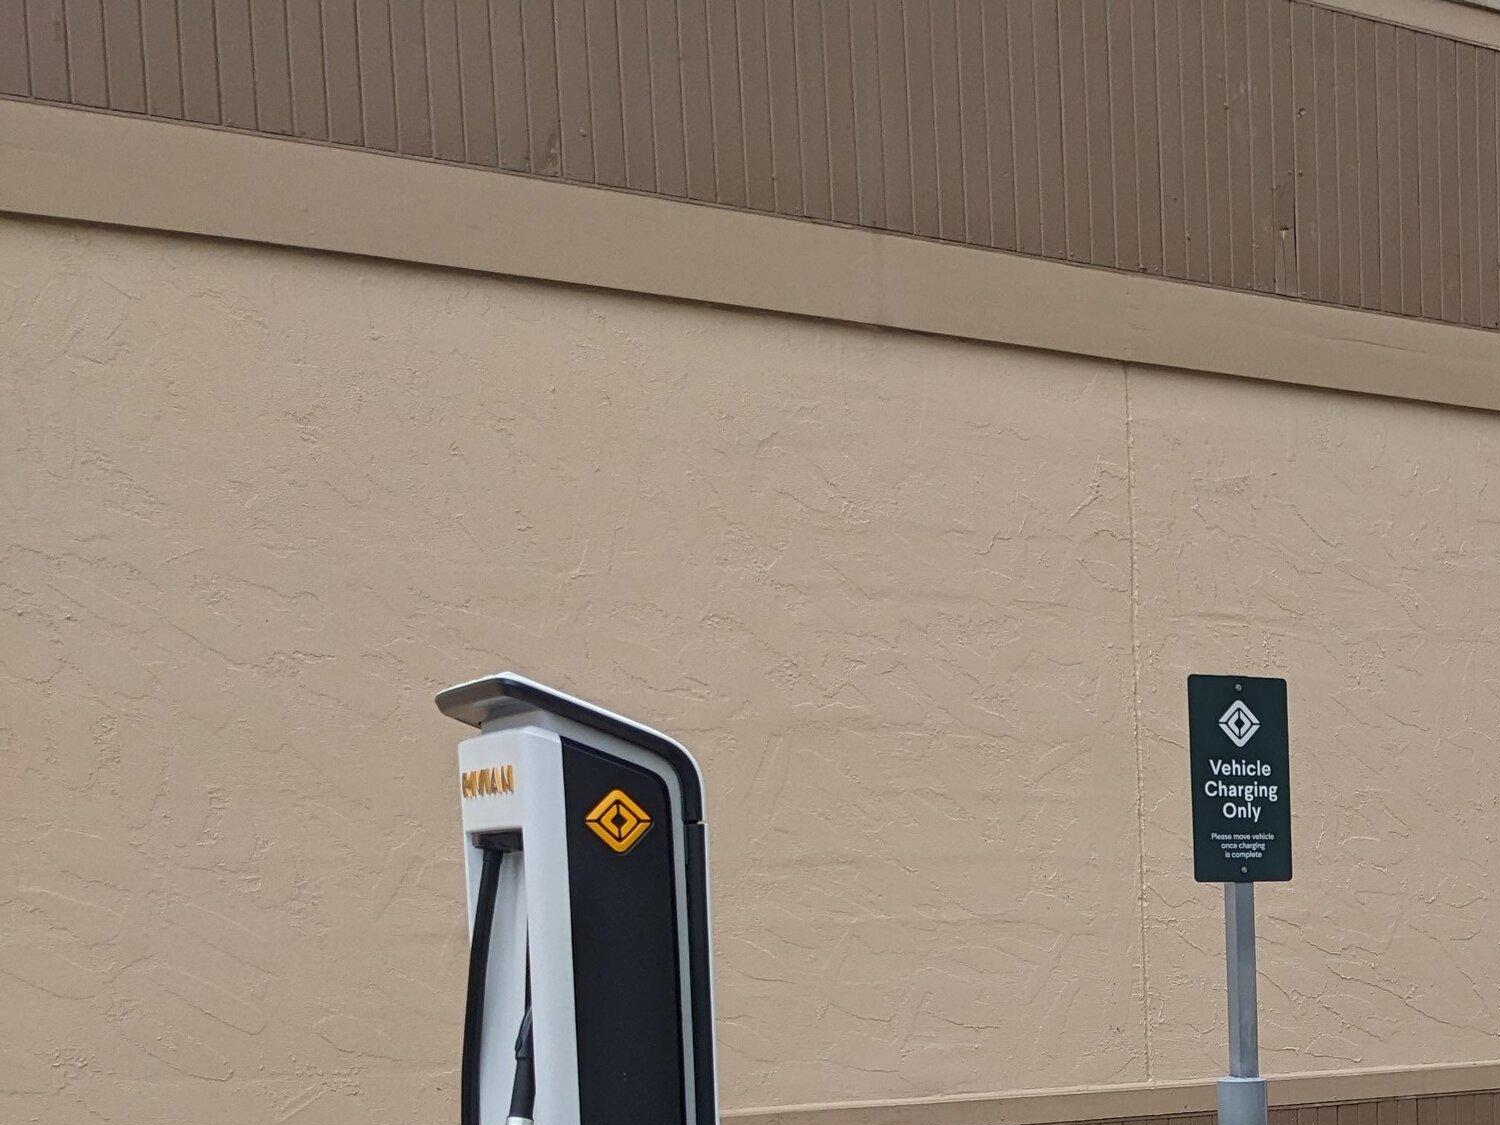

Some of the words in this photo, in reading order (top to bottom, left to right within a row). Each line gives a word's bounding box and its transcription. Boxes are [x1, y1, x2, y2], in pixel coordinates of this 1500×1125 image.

[1209, 759, 1271, 776] Vehicle
[1204, 780, 1278, 802] Charging
[1222, 802, 1262, 823] Only
[1211, 832, 1232, 840] Please
[1252, 832, 1274, 840] vehicle
[1238, 841, 1266, 851] charging
[1231, 851, 1262, 860] complete
